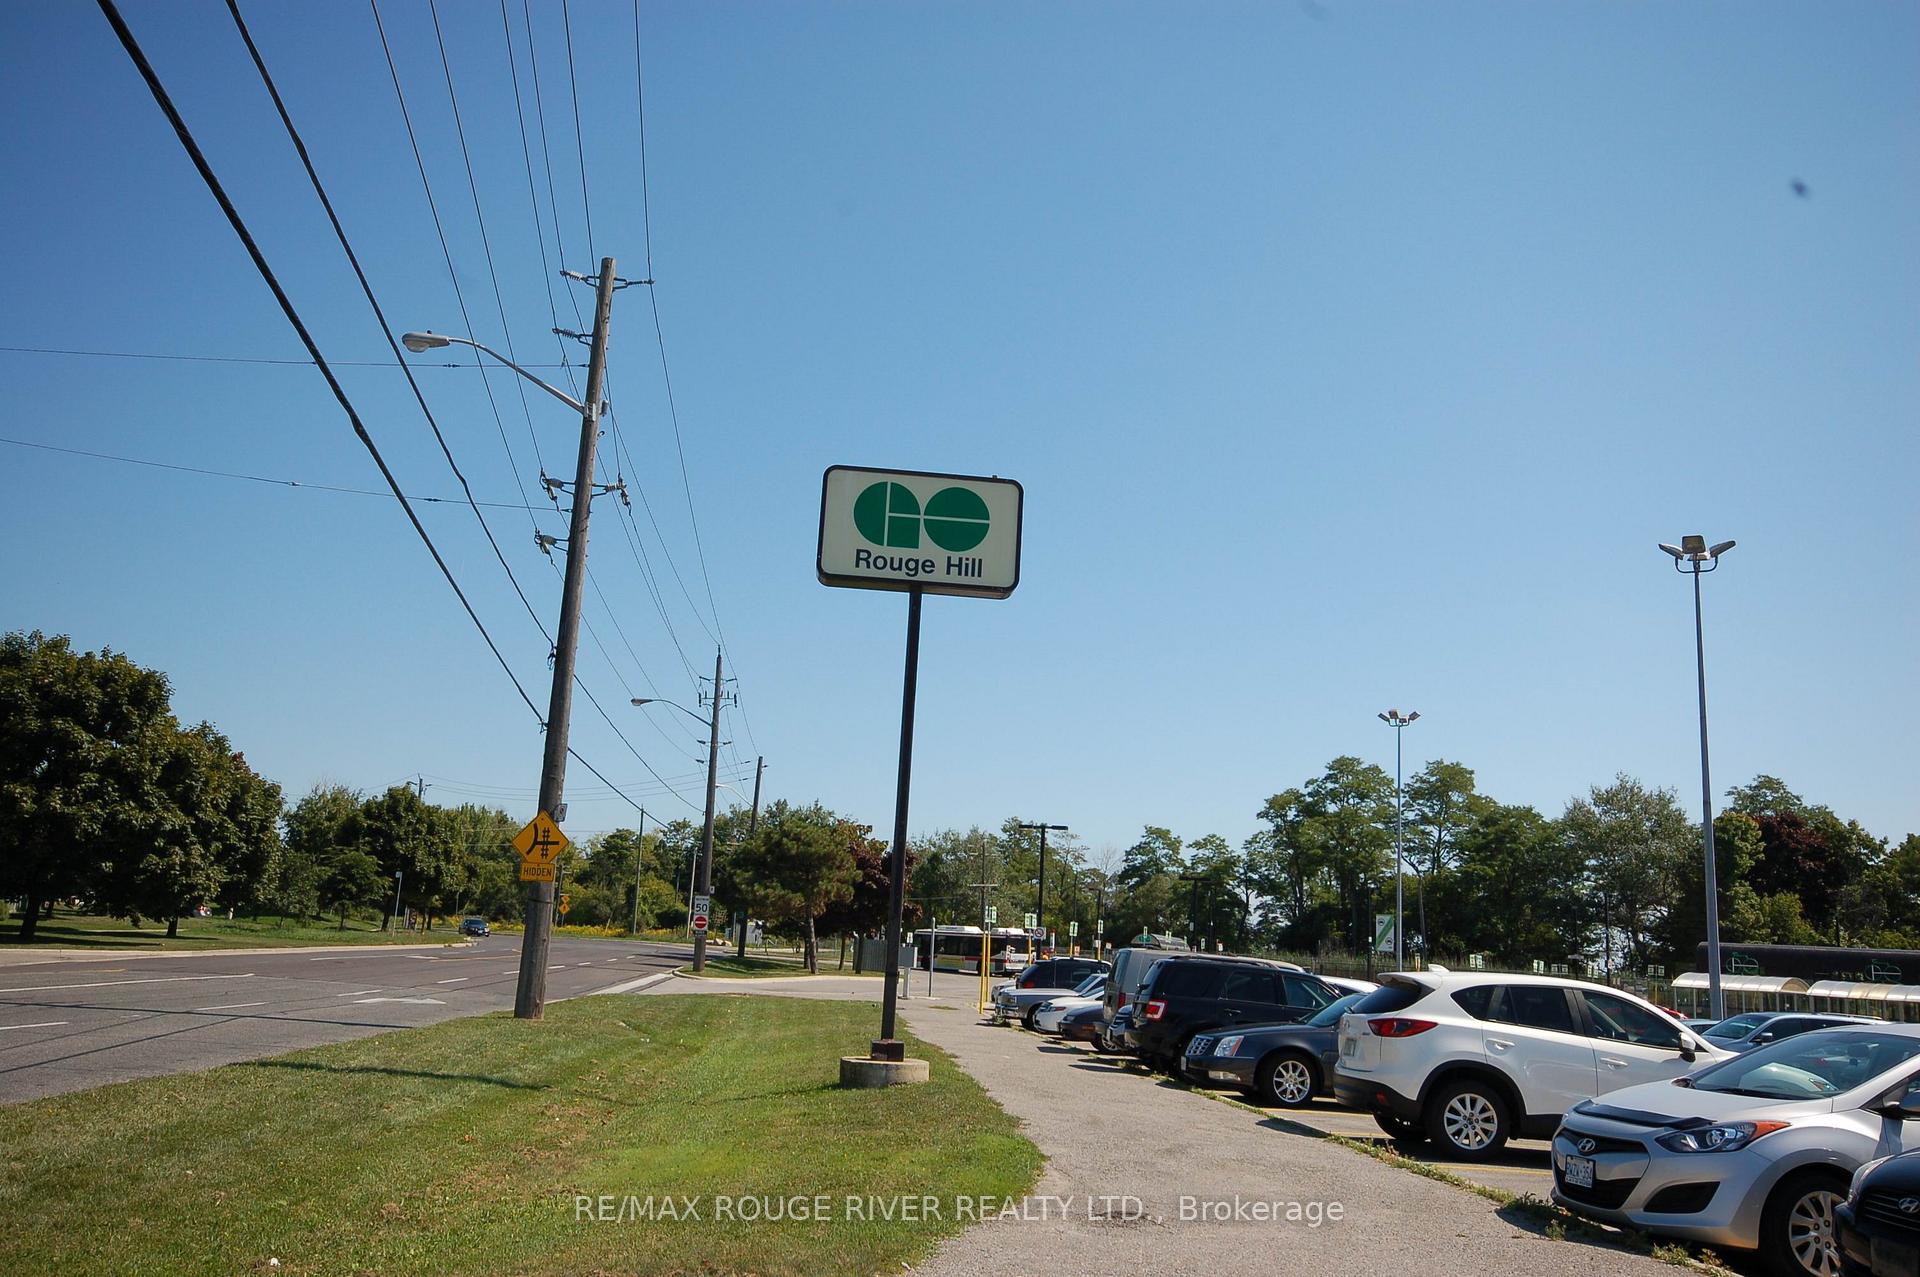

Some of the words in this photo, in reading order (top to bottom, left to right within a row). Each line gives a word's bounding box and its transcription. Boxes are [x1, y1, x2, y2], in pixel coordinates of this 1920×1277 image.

[853, 481, 991, 553] GO
[855, 548, 936, 577] Rouge
[945, 556, 983, 578] Hill
[523, 867, 552, 877] HIDDEN
[695, 903, 708, 913] 50
